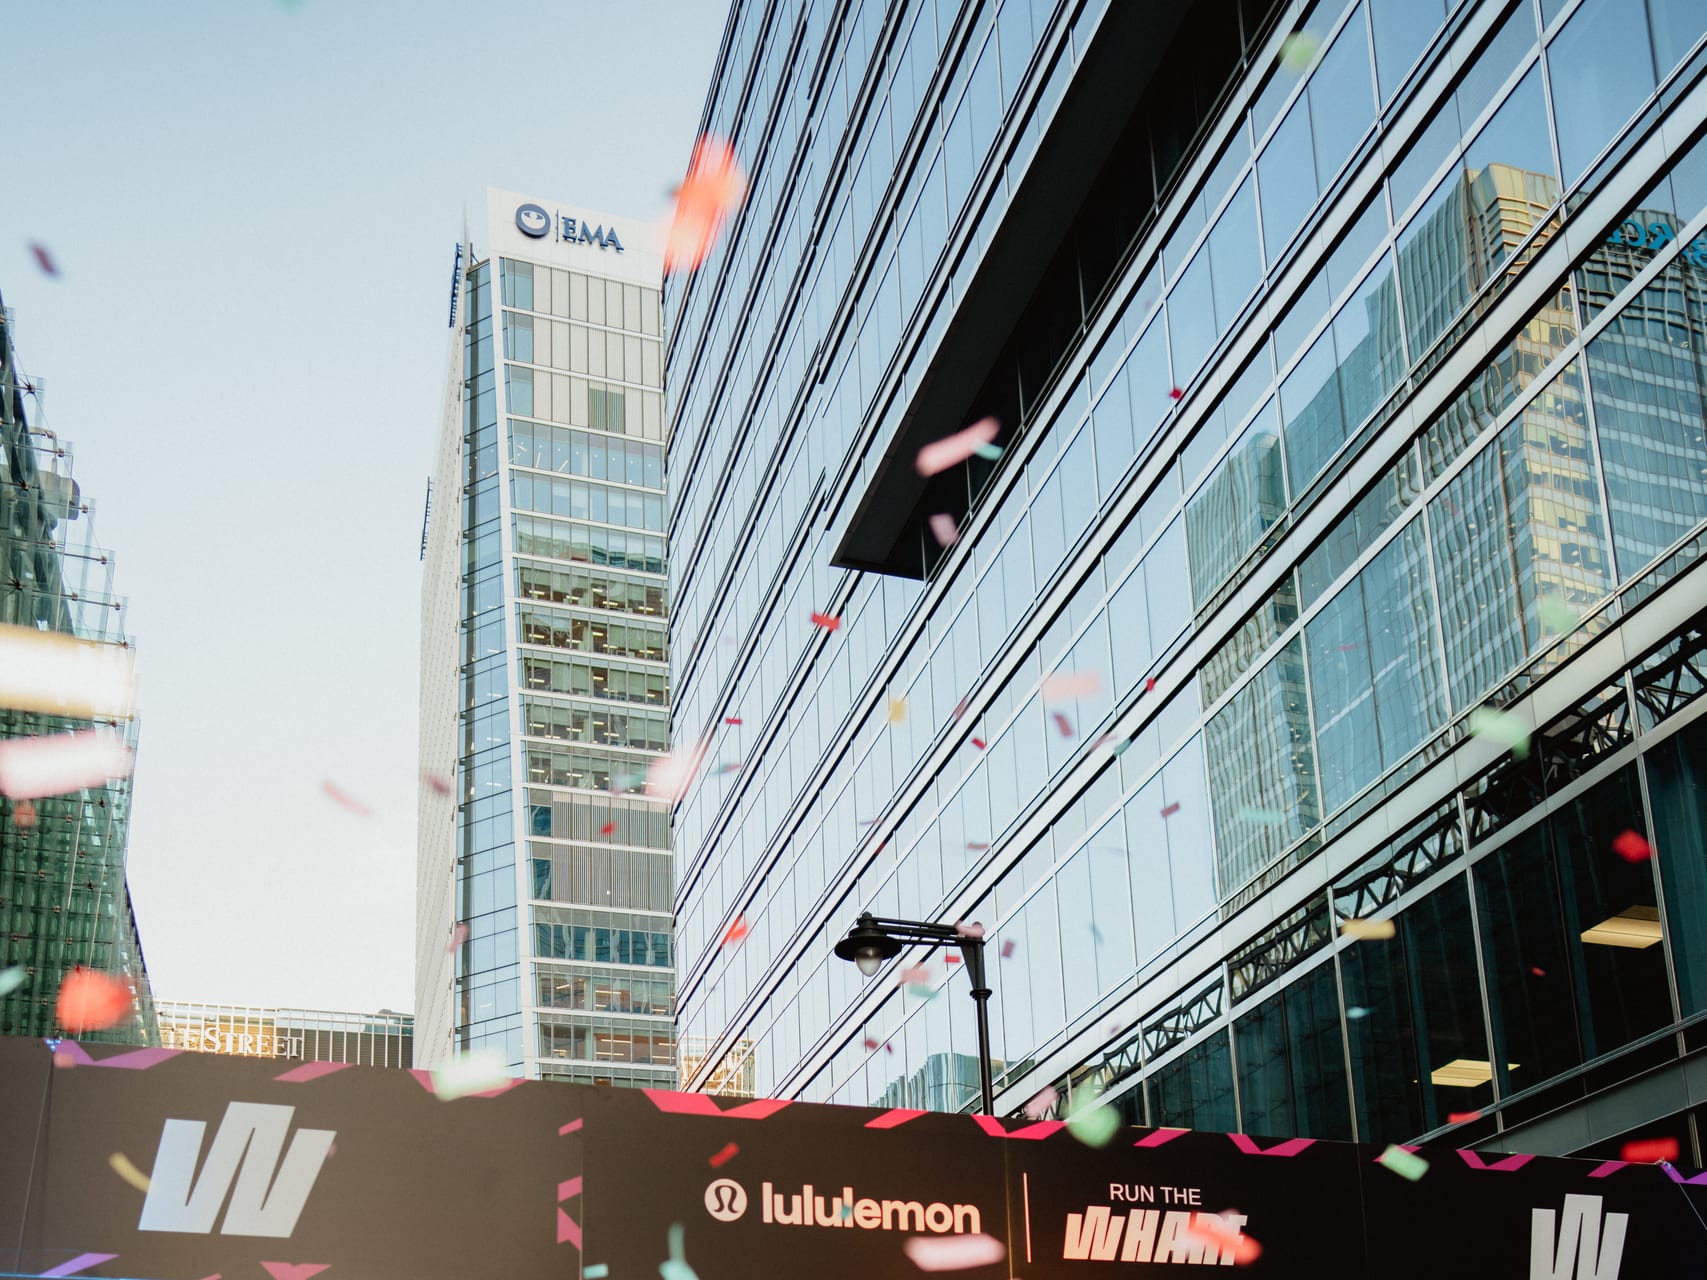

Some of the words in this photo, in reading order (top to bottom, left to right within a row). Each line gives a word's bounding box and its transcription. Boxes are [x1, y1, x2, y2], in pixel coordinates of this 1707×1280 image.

[561, 216, 625, 252] EMA
[204, 1026, 303, 1057] STREET
[761, 1181, 982, 1235] lululemon
[1109, 1183, 1155, 1204] RUN
[1159, 1186, 1203, 1206] THE
